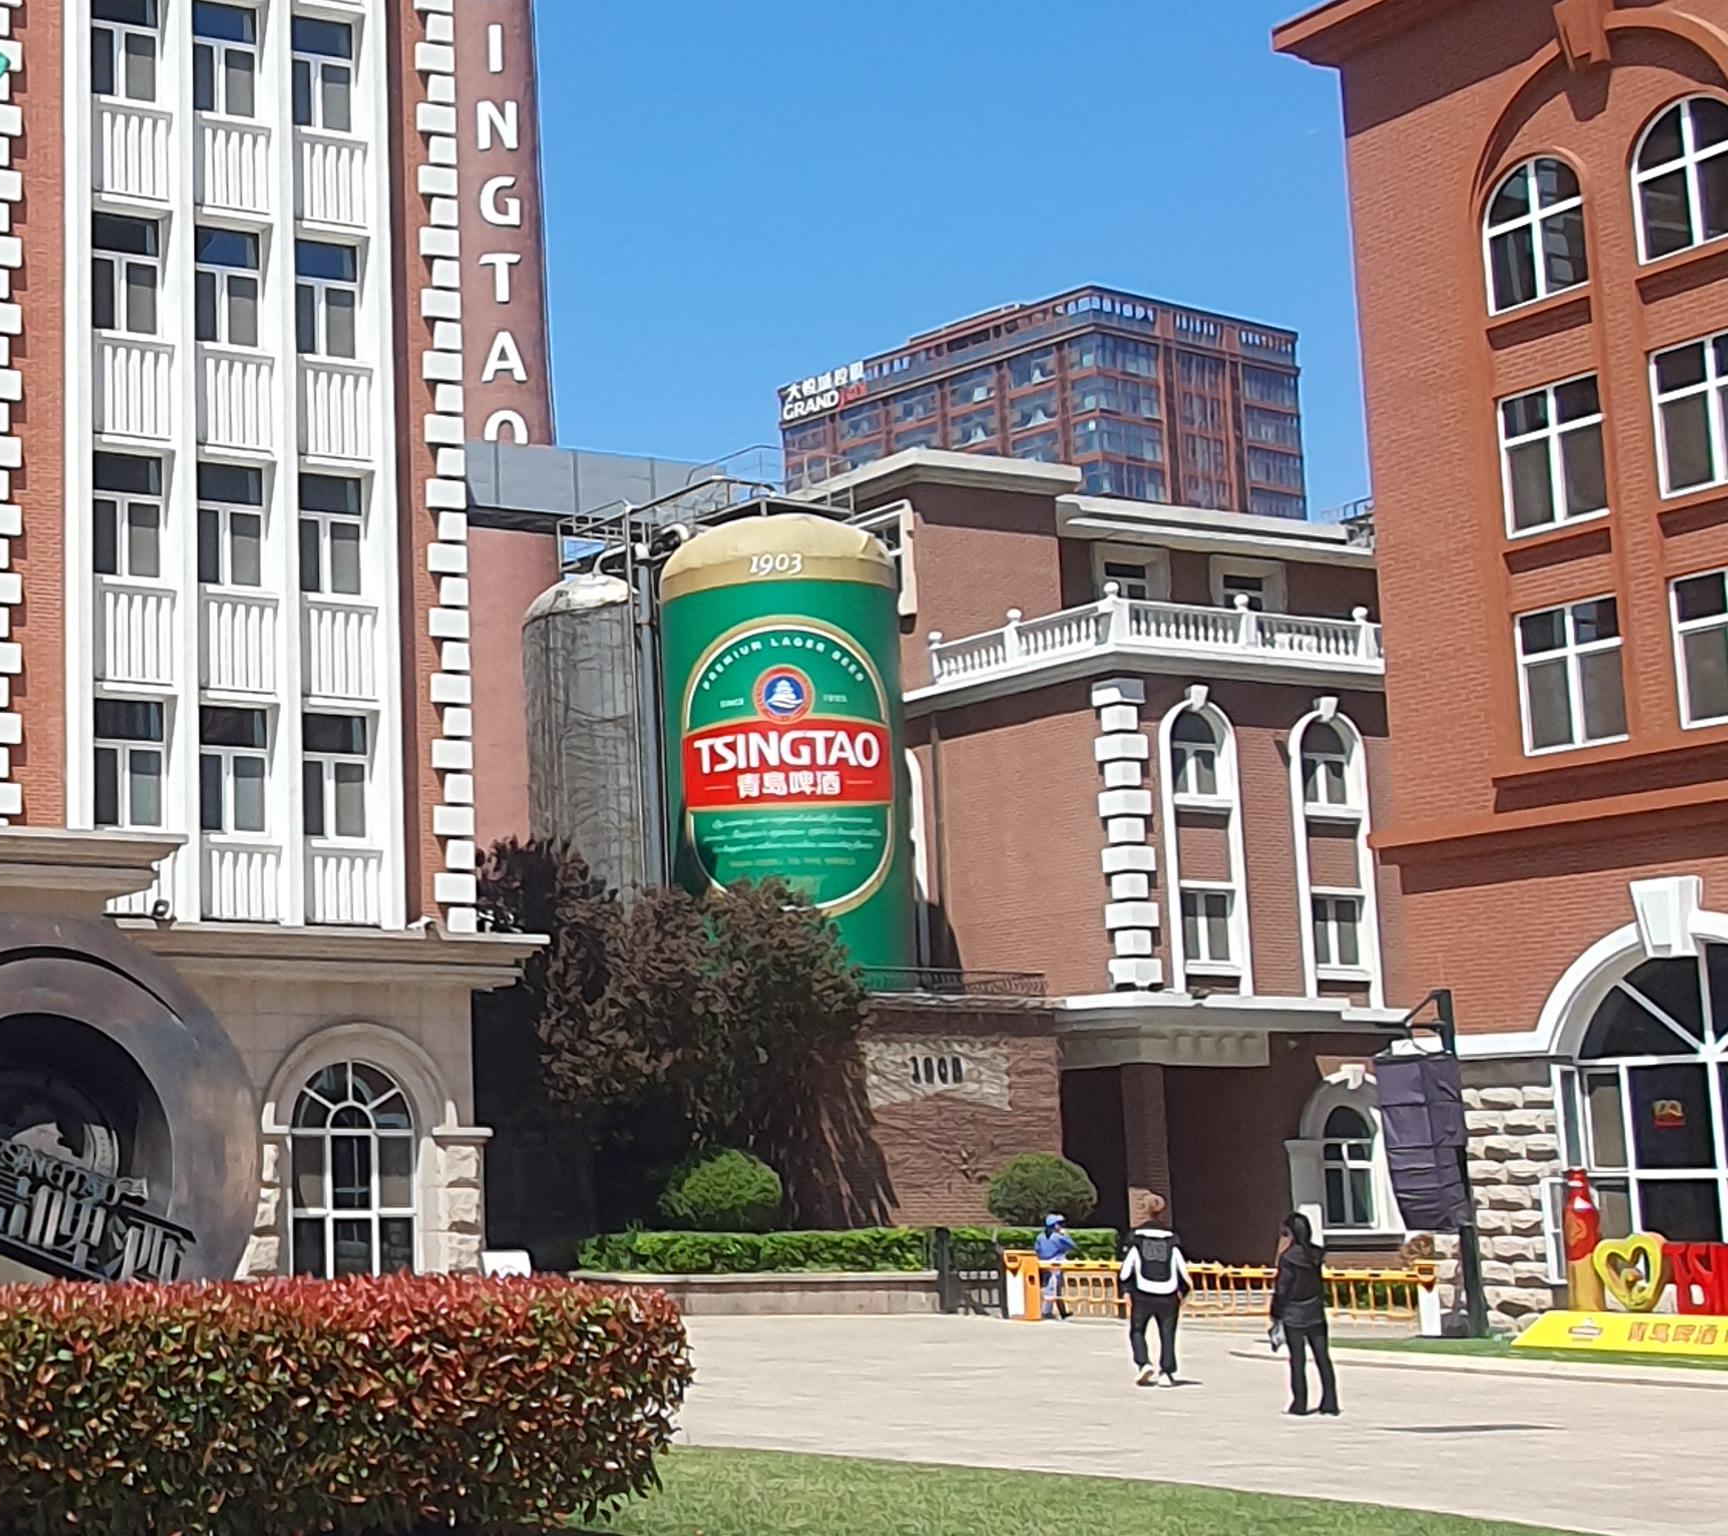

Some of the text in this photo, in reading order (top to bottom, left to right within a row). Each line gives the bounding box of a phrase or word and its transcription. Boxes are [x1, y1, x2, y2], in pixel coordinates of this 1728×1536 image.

[749, 553, 803, 575] 1903
[770, 636, 826, 653] LAGER
[693, 729, 881, 774] TSINGTAO
